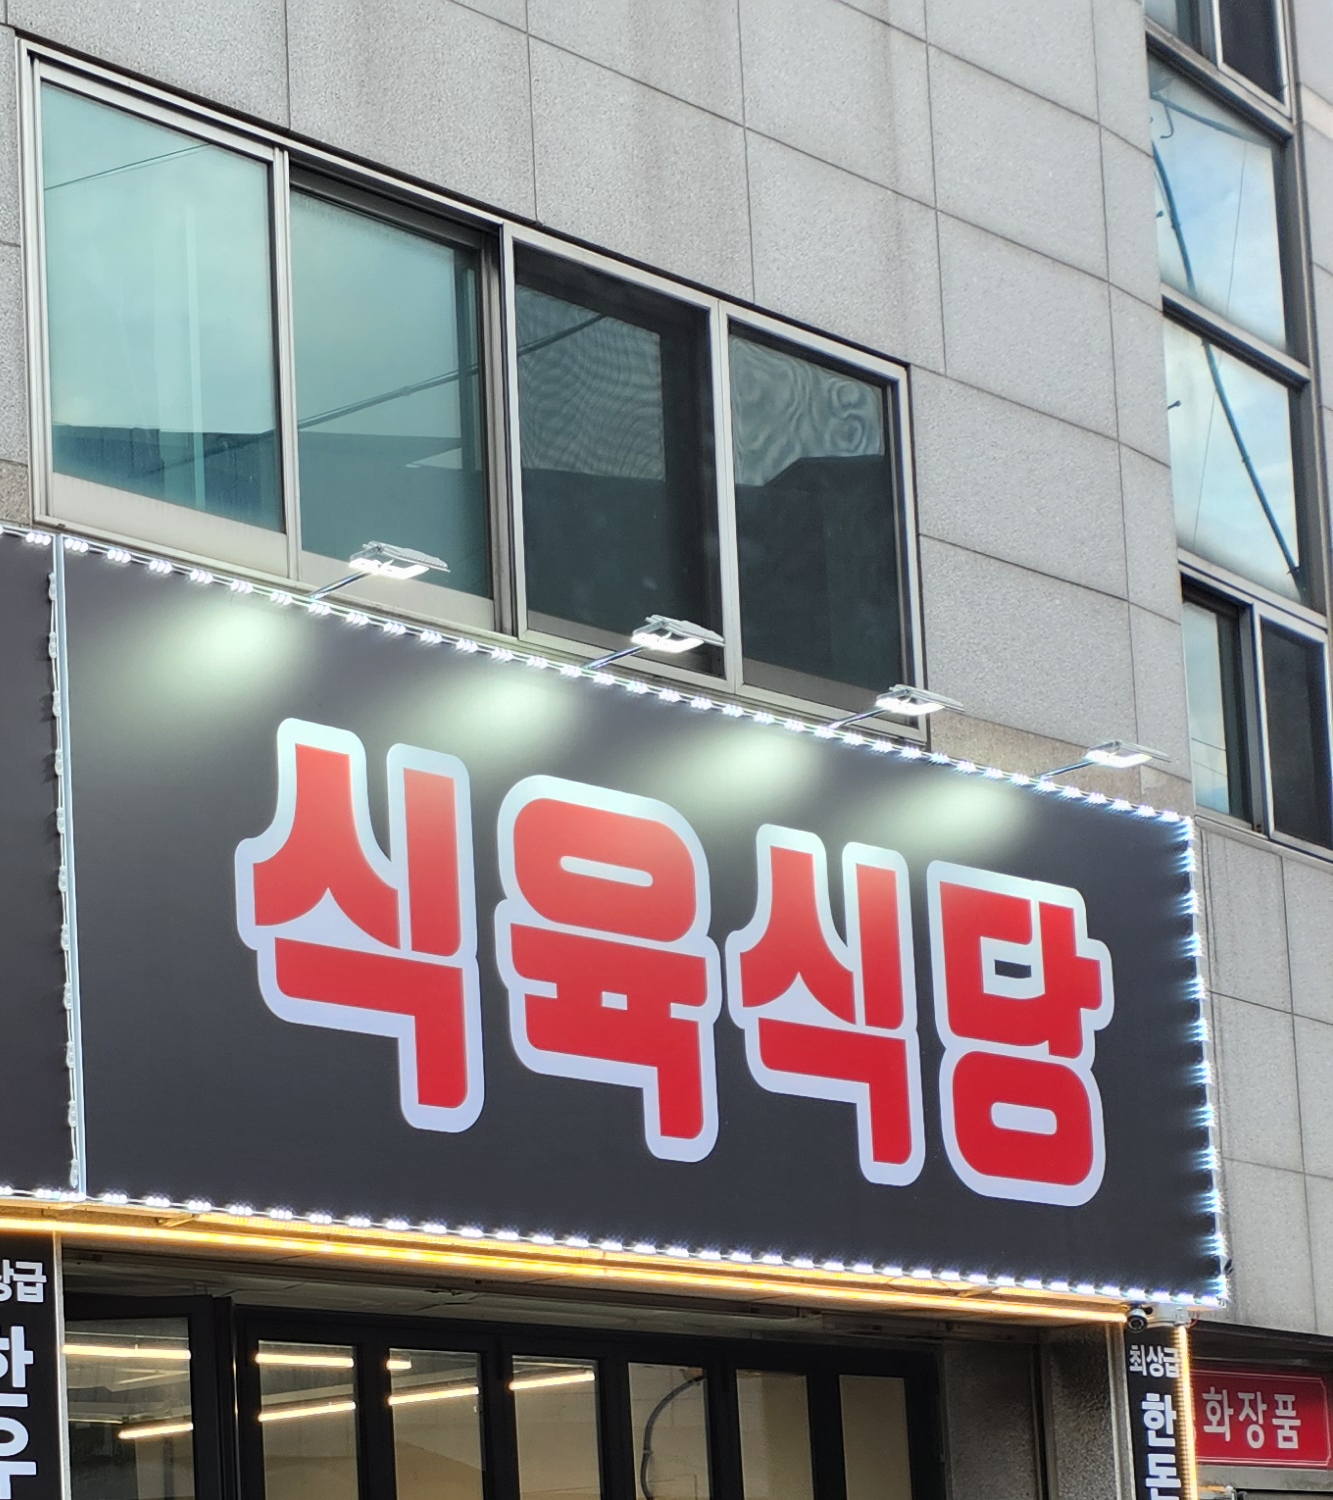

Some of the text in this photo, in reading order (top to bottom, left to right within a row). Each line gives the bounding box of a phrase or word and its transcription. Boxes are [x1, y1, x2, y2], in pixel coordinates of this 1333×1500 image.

[234, 717, 1113, 1206] 식육식당
[1129, 1345, 1181, 1378] 최상급
[1202, 1386, 1302, 1450] 화장품
